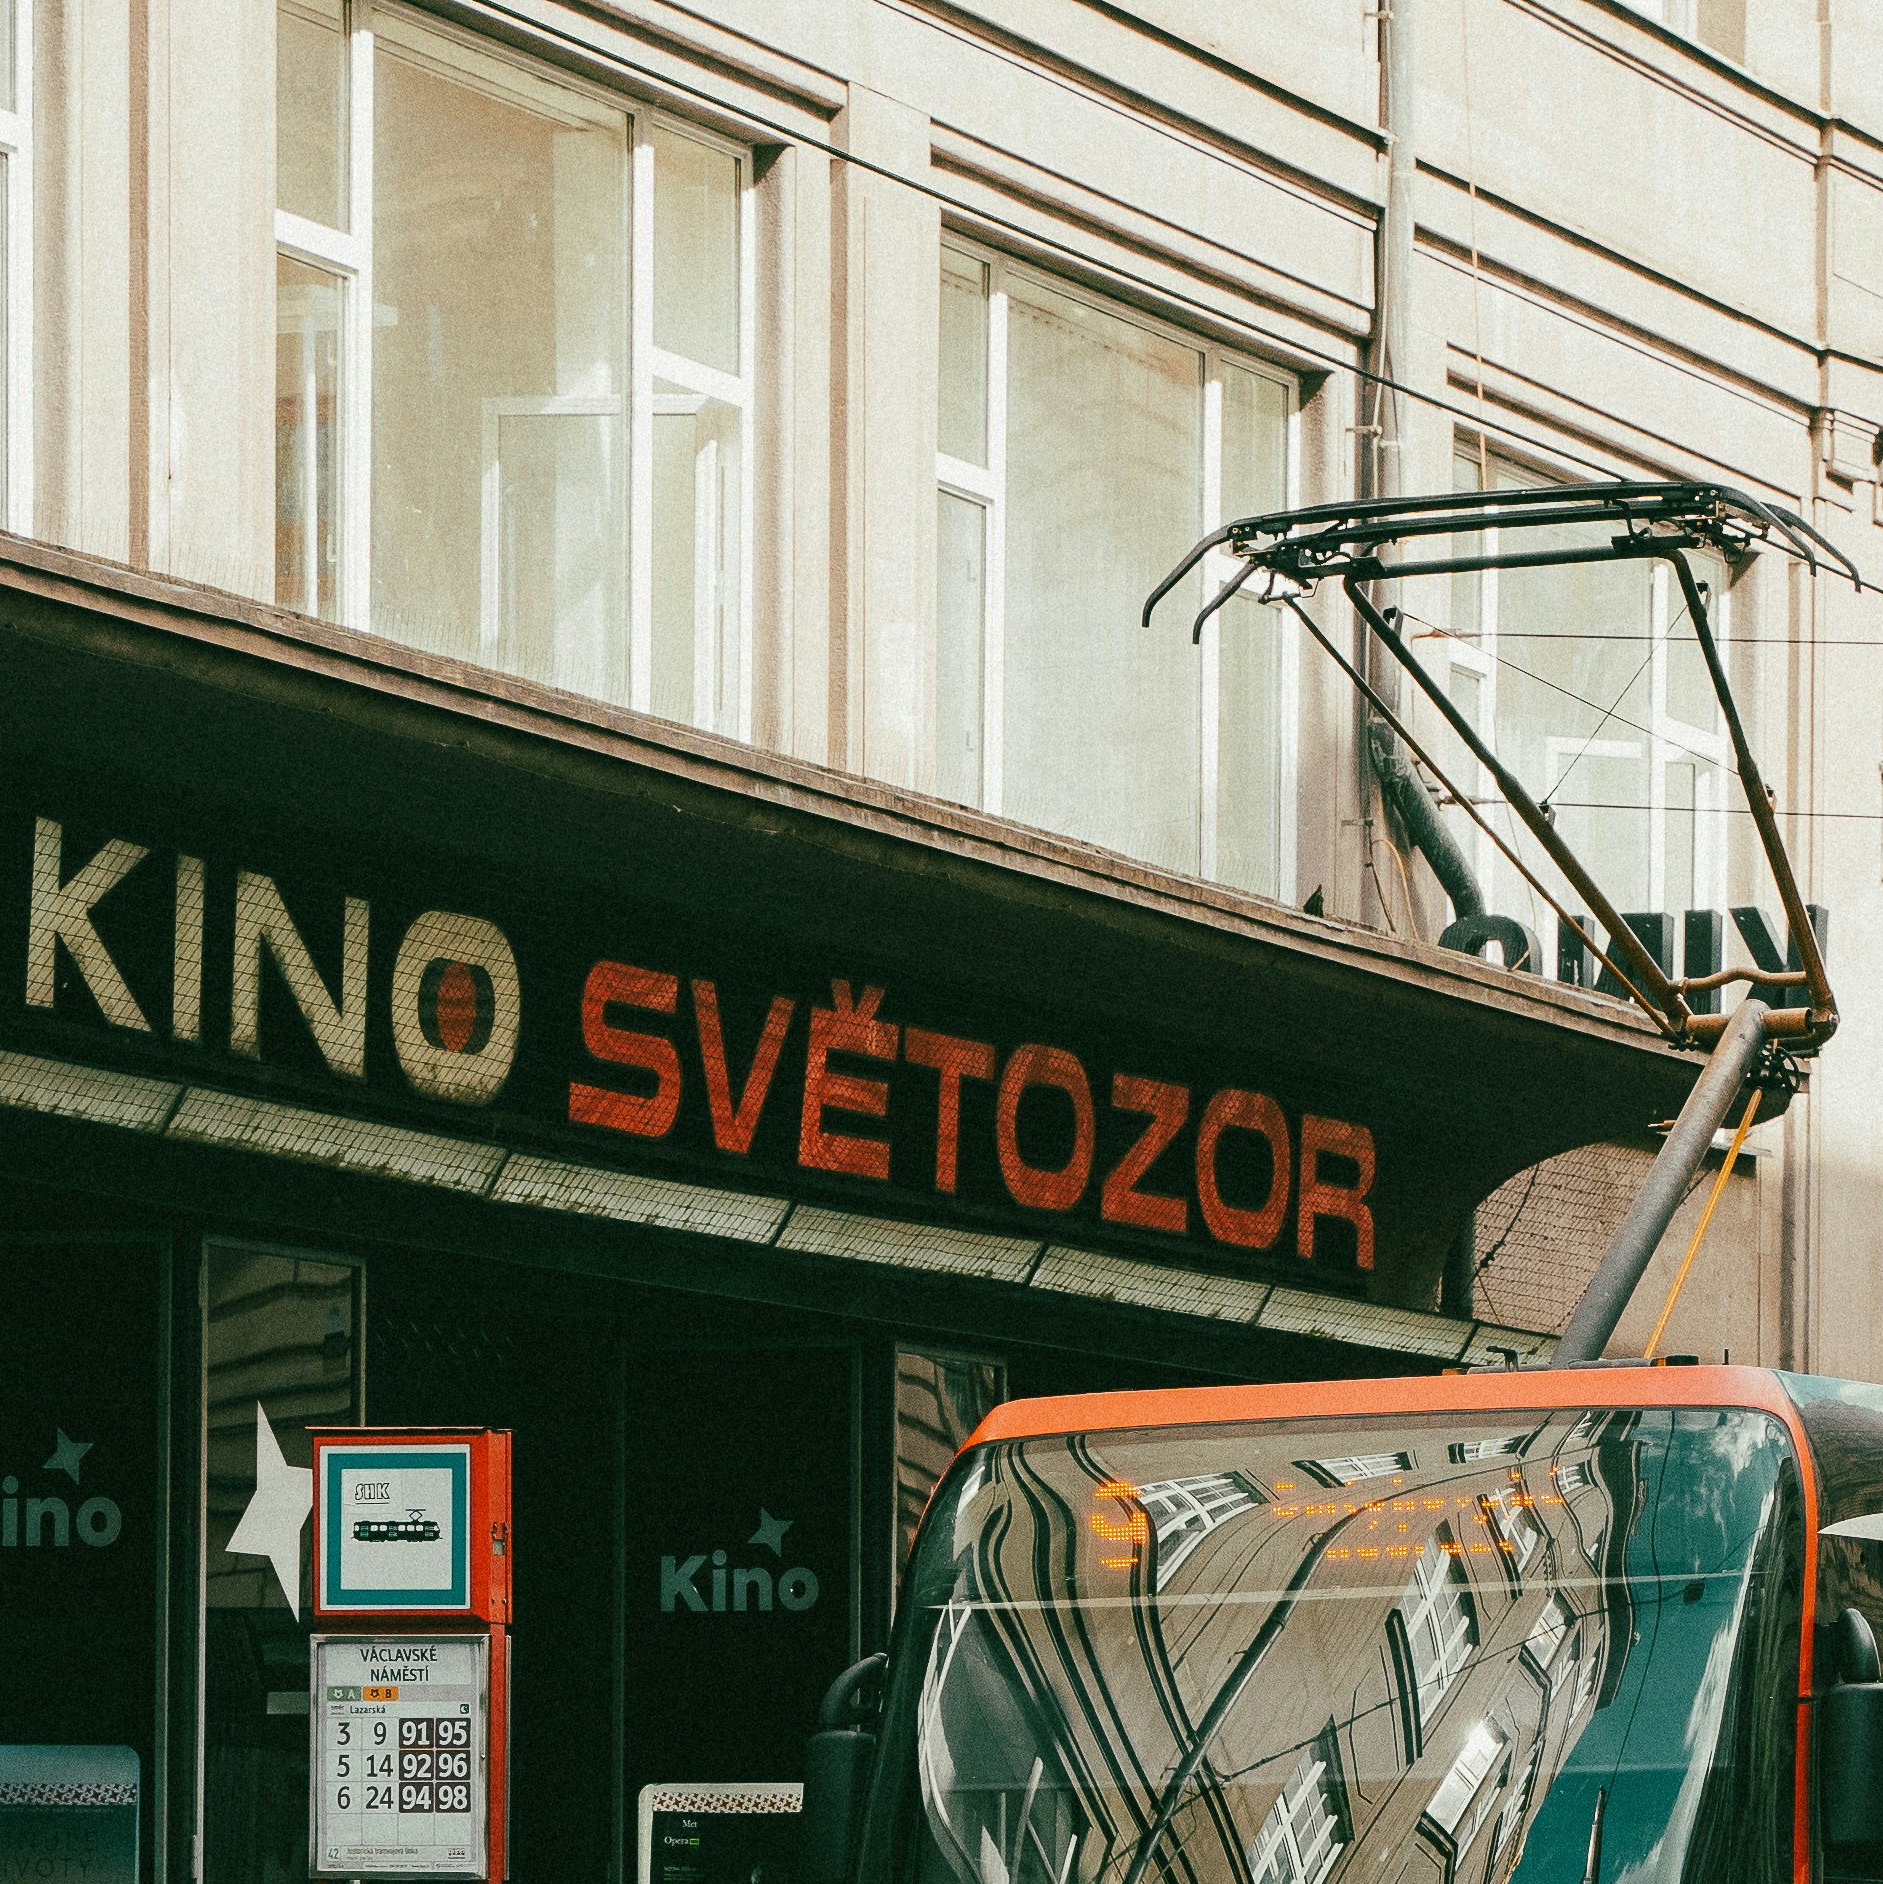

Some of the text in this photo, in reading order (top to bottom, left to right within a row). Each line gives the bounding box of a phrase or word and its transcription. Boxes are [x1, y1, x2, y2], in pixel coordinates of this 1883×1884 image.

[25, 817, 1376, 1271] KINO SVĚTOZOR
[660, 1549, 819, 1612] Kino
[360, 1645, 438, 1662] VÁCLAVSKÉ
[370, 1665, 429, 1682] NÁMĚSTÍ
[347, 1689, 392, 1699] A B
[350, 1705, 386, 1714] Lazarská
[337, 1721, 467, 1746] 3 9 91 95
[337, 1753, 468, 1778] 5 14 92 96
[337, 1785, 468, 1810] 6 24 94 98
[664, 1836, 689, 1847] Opera
[328, 1847, 340, 1860] 42
